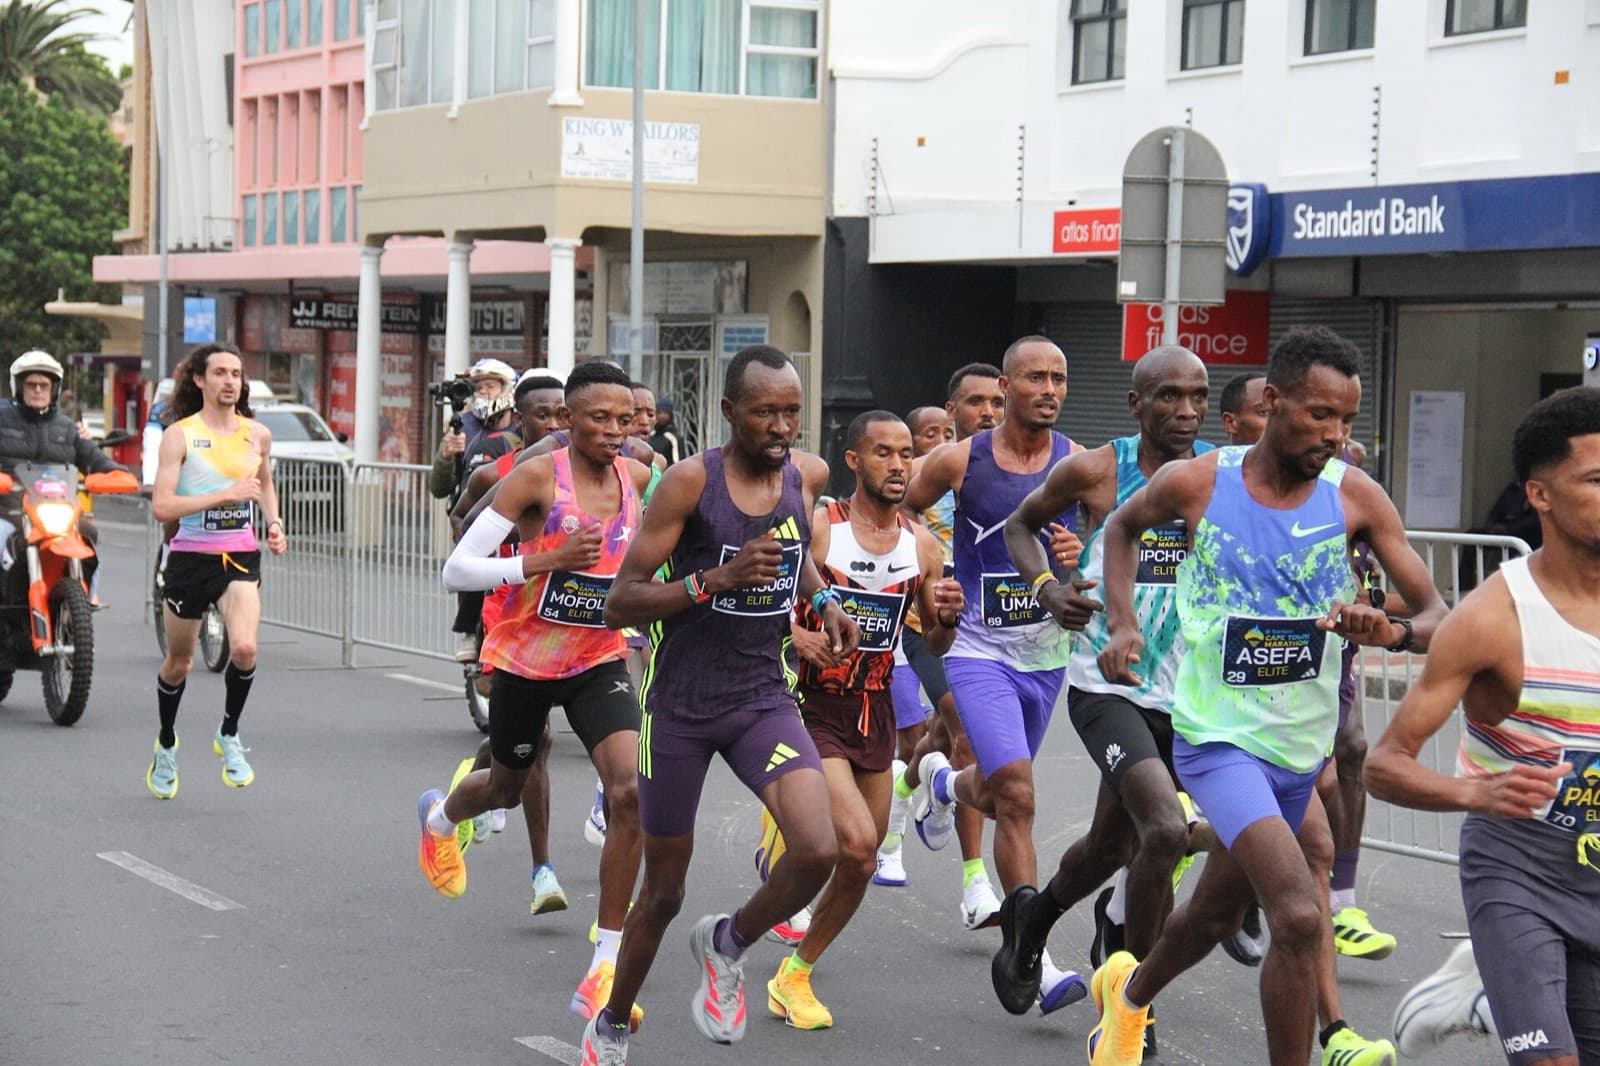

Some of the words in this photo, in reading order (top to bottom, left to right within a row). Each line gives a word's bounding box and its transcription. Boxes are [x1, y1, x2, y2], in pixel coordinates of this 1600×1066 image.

[565, 119, 605, 137] KING
[610, 121, 626, 137] W
[630, 122, 698, 142] AILORS
[1294, 199, 1386, 239] Standard
[1389, 194, 1446, 236] Bank
[1061, 221, 1088, 243] atlas
[1092, 219, 1121, 243] finan
[292, 301, 316, 318] JJ
[1147, 303, 1210, 324] aas
[1147, 326, 1248, 354] fiance
[208, 510, 249, 519] REICHOW
[1140, 550, 1186, 562] IPCHO
[1153, 566, 1177, 576] ELIT
[550, 590, 605, 610] MOFOL
[719, 597, 736, 609] 42
[746, 595, 774, 606] ELITE
[543, 607, 560, 619] 54
[568, 608, 594, 619] ELITE
[988, 616, 1002, 626] 69
[1009, 610, 1033, 620] ELITE
[1264, 640, 1310, 648] MARATHON
[1236, 646, 1312, 665] ASEFA
[1226, 671, 1247, 683] 29
[1257, 665, 1289, 677] ELITE
[1553, 811, 1576, 827] 70
[1503, 1029, 1549, 1054] HOKA
